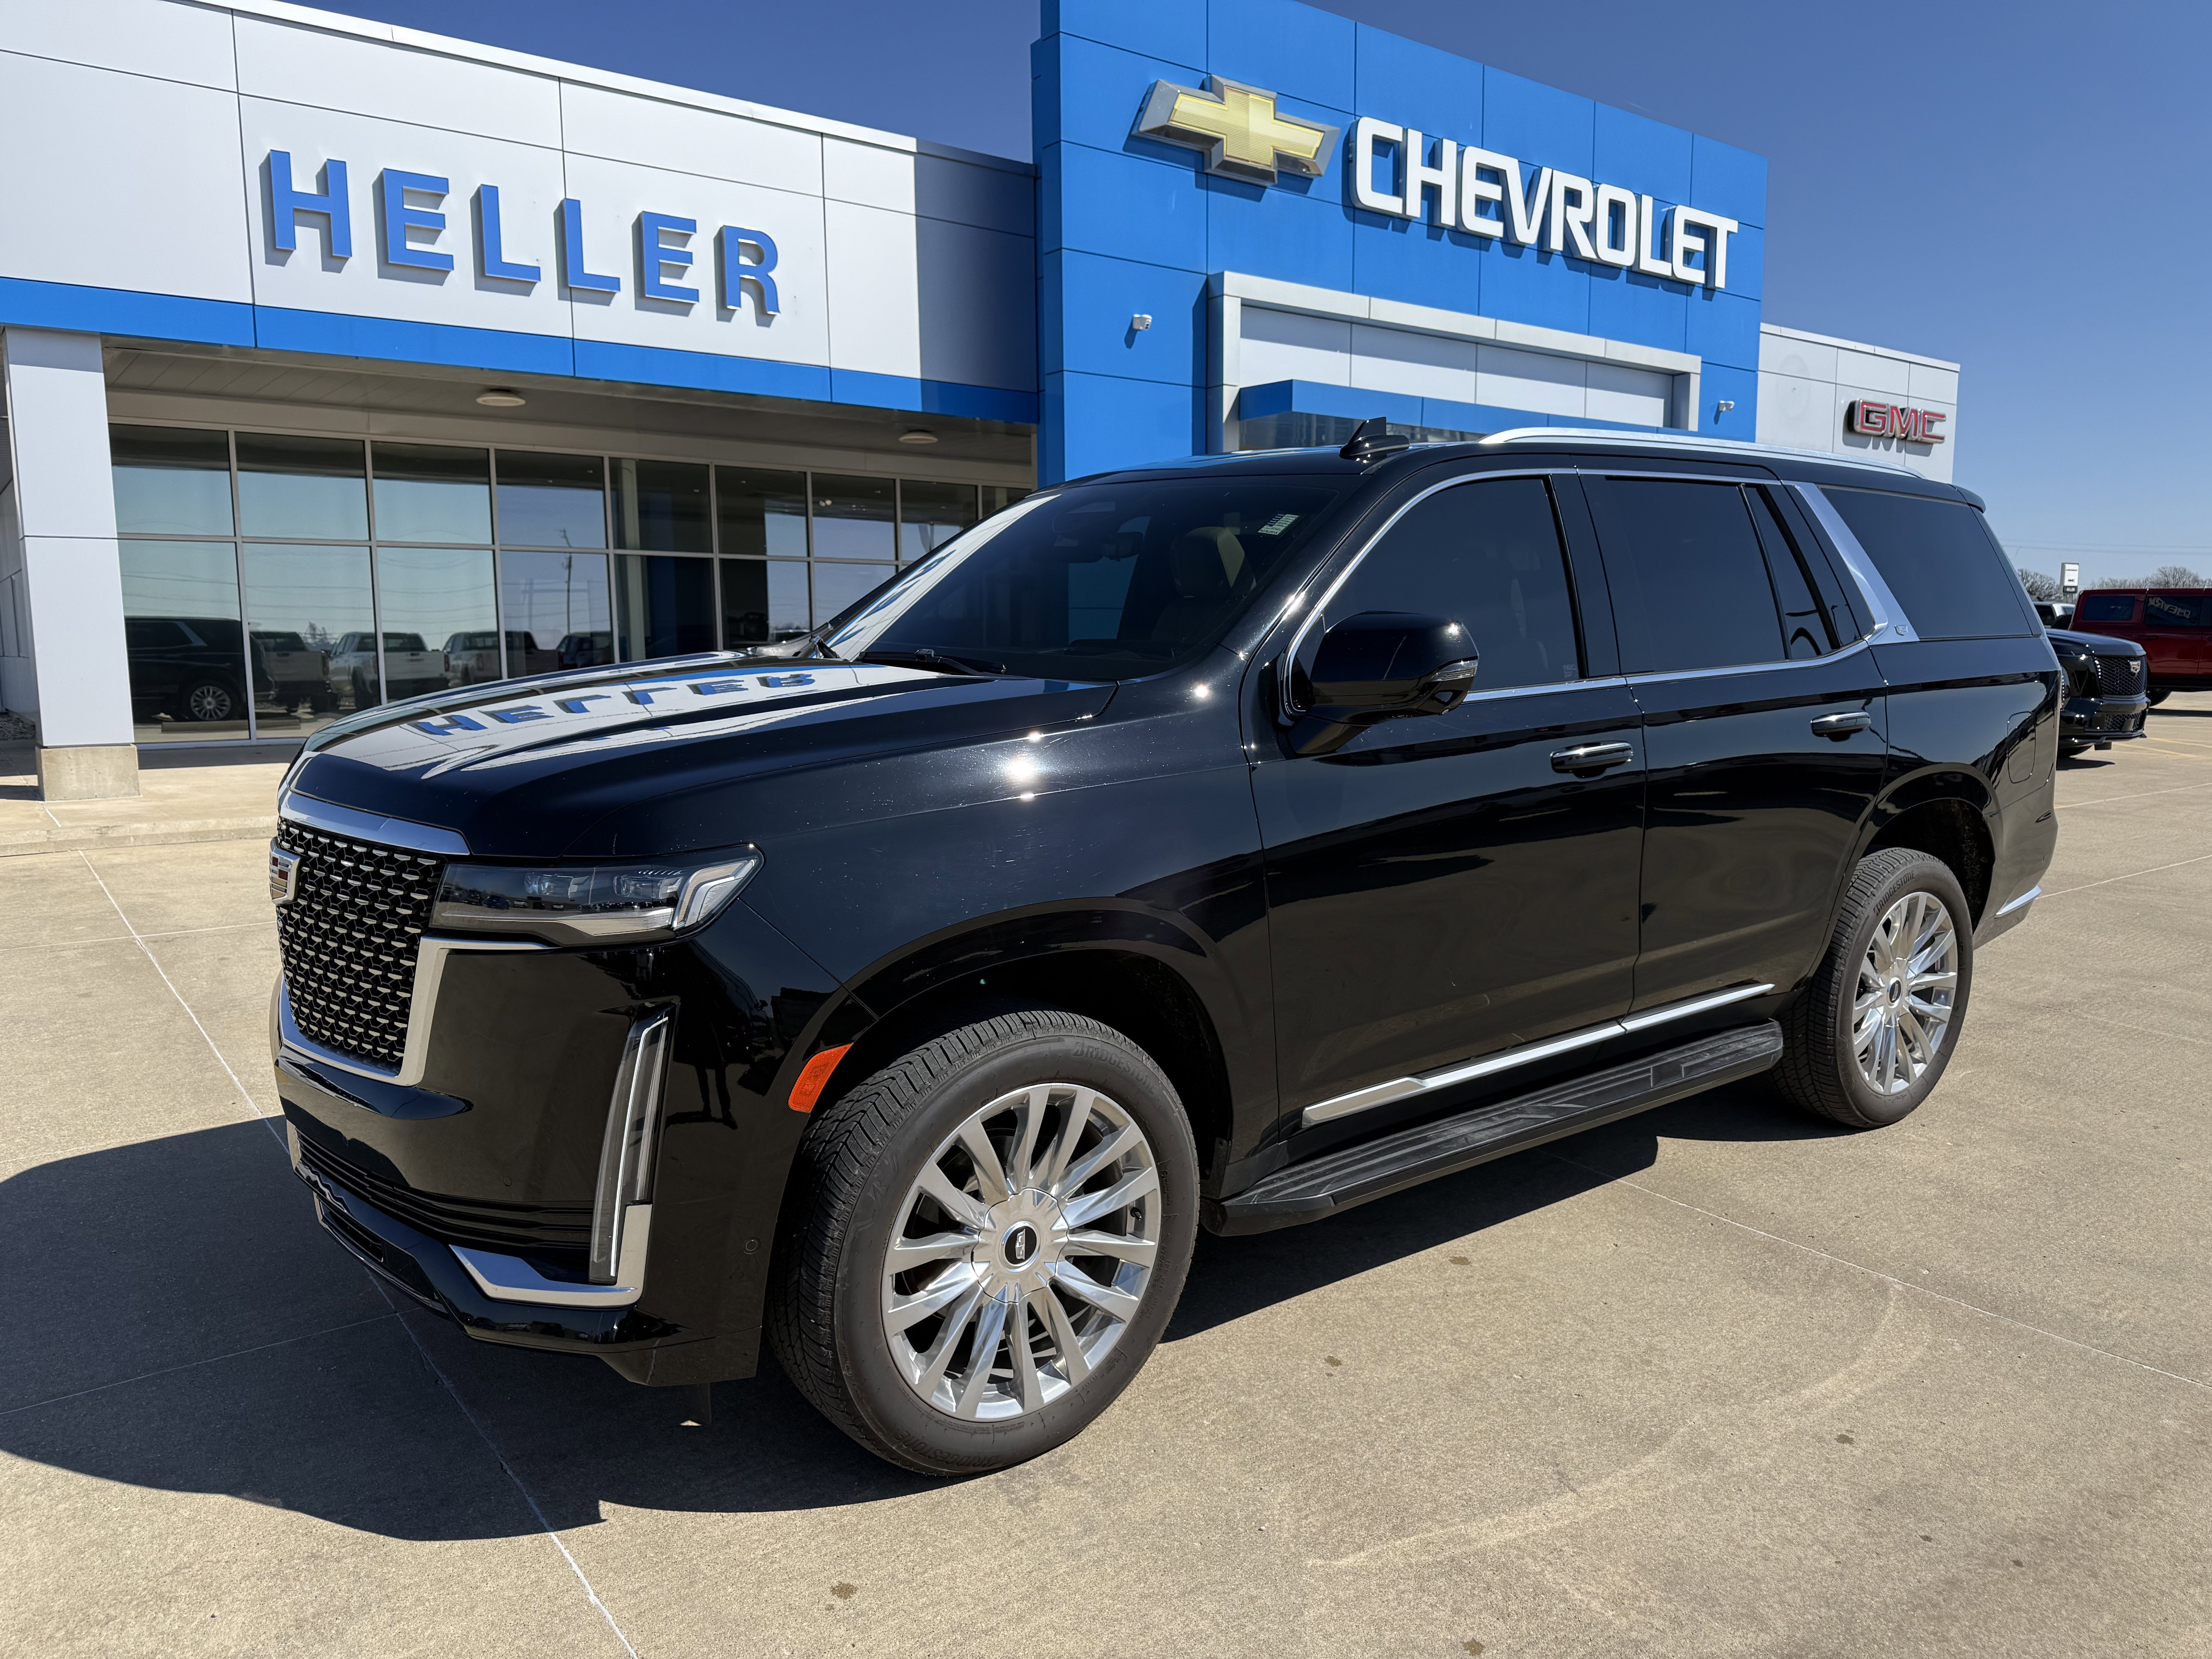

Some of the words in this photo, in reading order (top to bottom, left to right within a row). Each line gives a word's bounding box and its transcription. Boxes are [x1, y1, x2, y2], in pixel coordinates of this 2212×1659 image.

[1352, 116, 1738, 289] CHEVROLET
[268, 149, 780, 316] HELLER
[1853, 398, 1947, 444] GMC
[1873, 870, 1915, 917] BRIDGESTONE
[1072, 1042, 1160, 1096] BRIDGESTONE
[893, 1431, 1001, 1468] BRIDGESTONE
